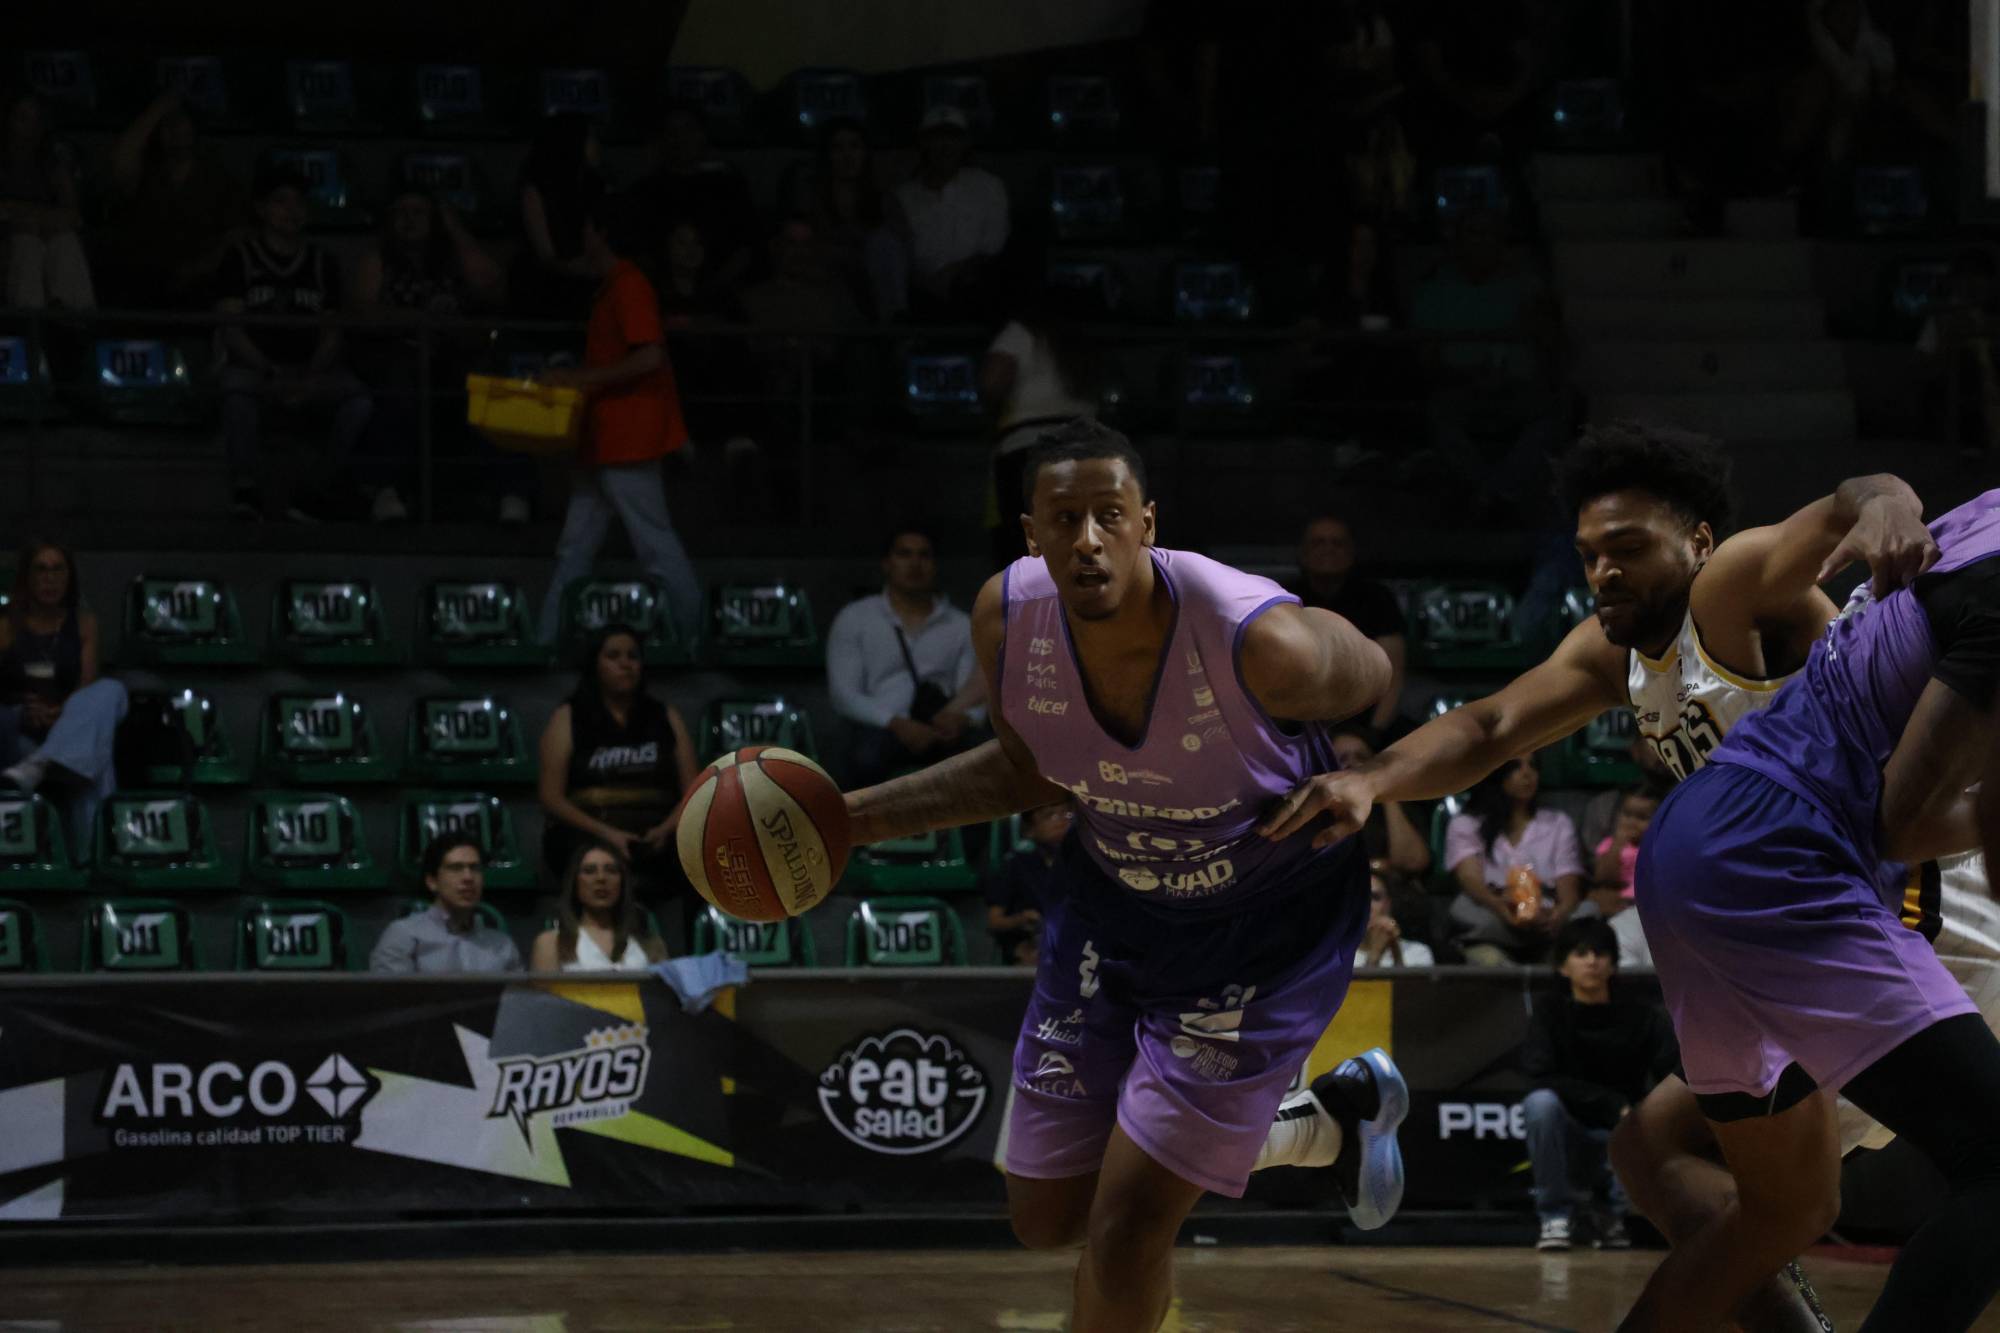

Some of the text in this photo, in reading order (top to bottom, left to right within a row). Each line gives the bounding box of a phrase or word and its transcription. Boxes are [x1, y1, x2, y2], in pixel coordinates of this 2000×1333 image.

[102, 1060, 297, 1119] ARCO
[487, 1044, 644, 1134] RAYOS
[848, 1057, 950, 1108] eat
[114, 1125, 346, 1148] Gasolina calidad TOP TIER
[853, 1106, 946, 1140] salad
